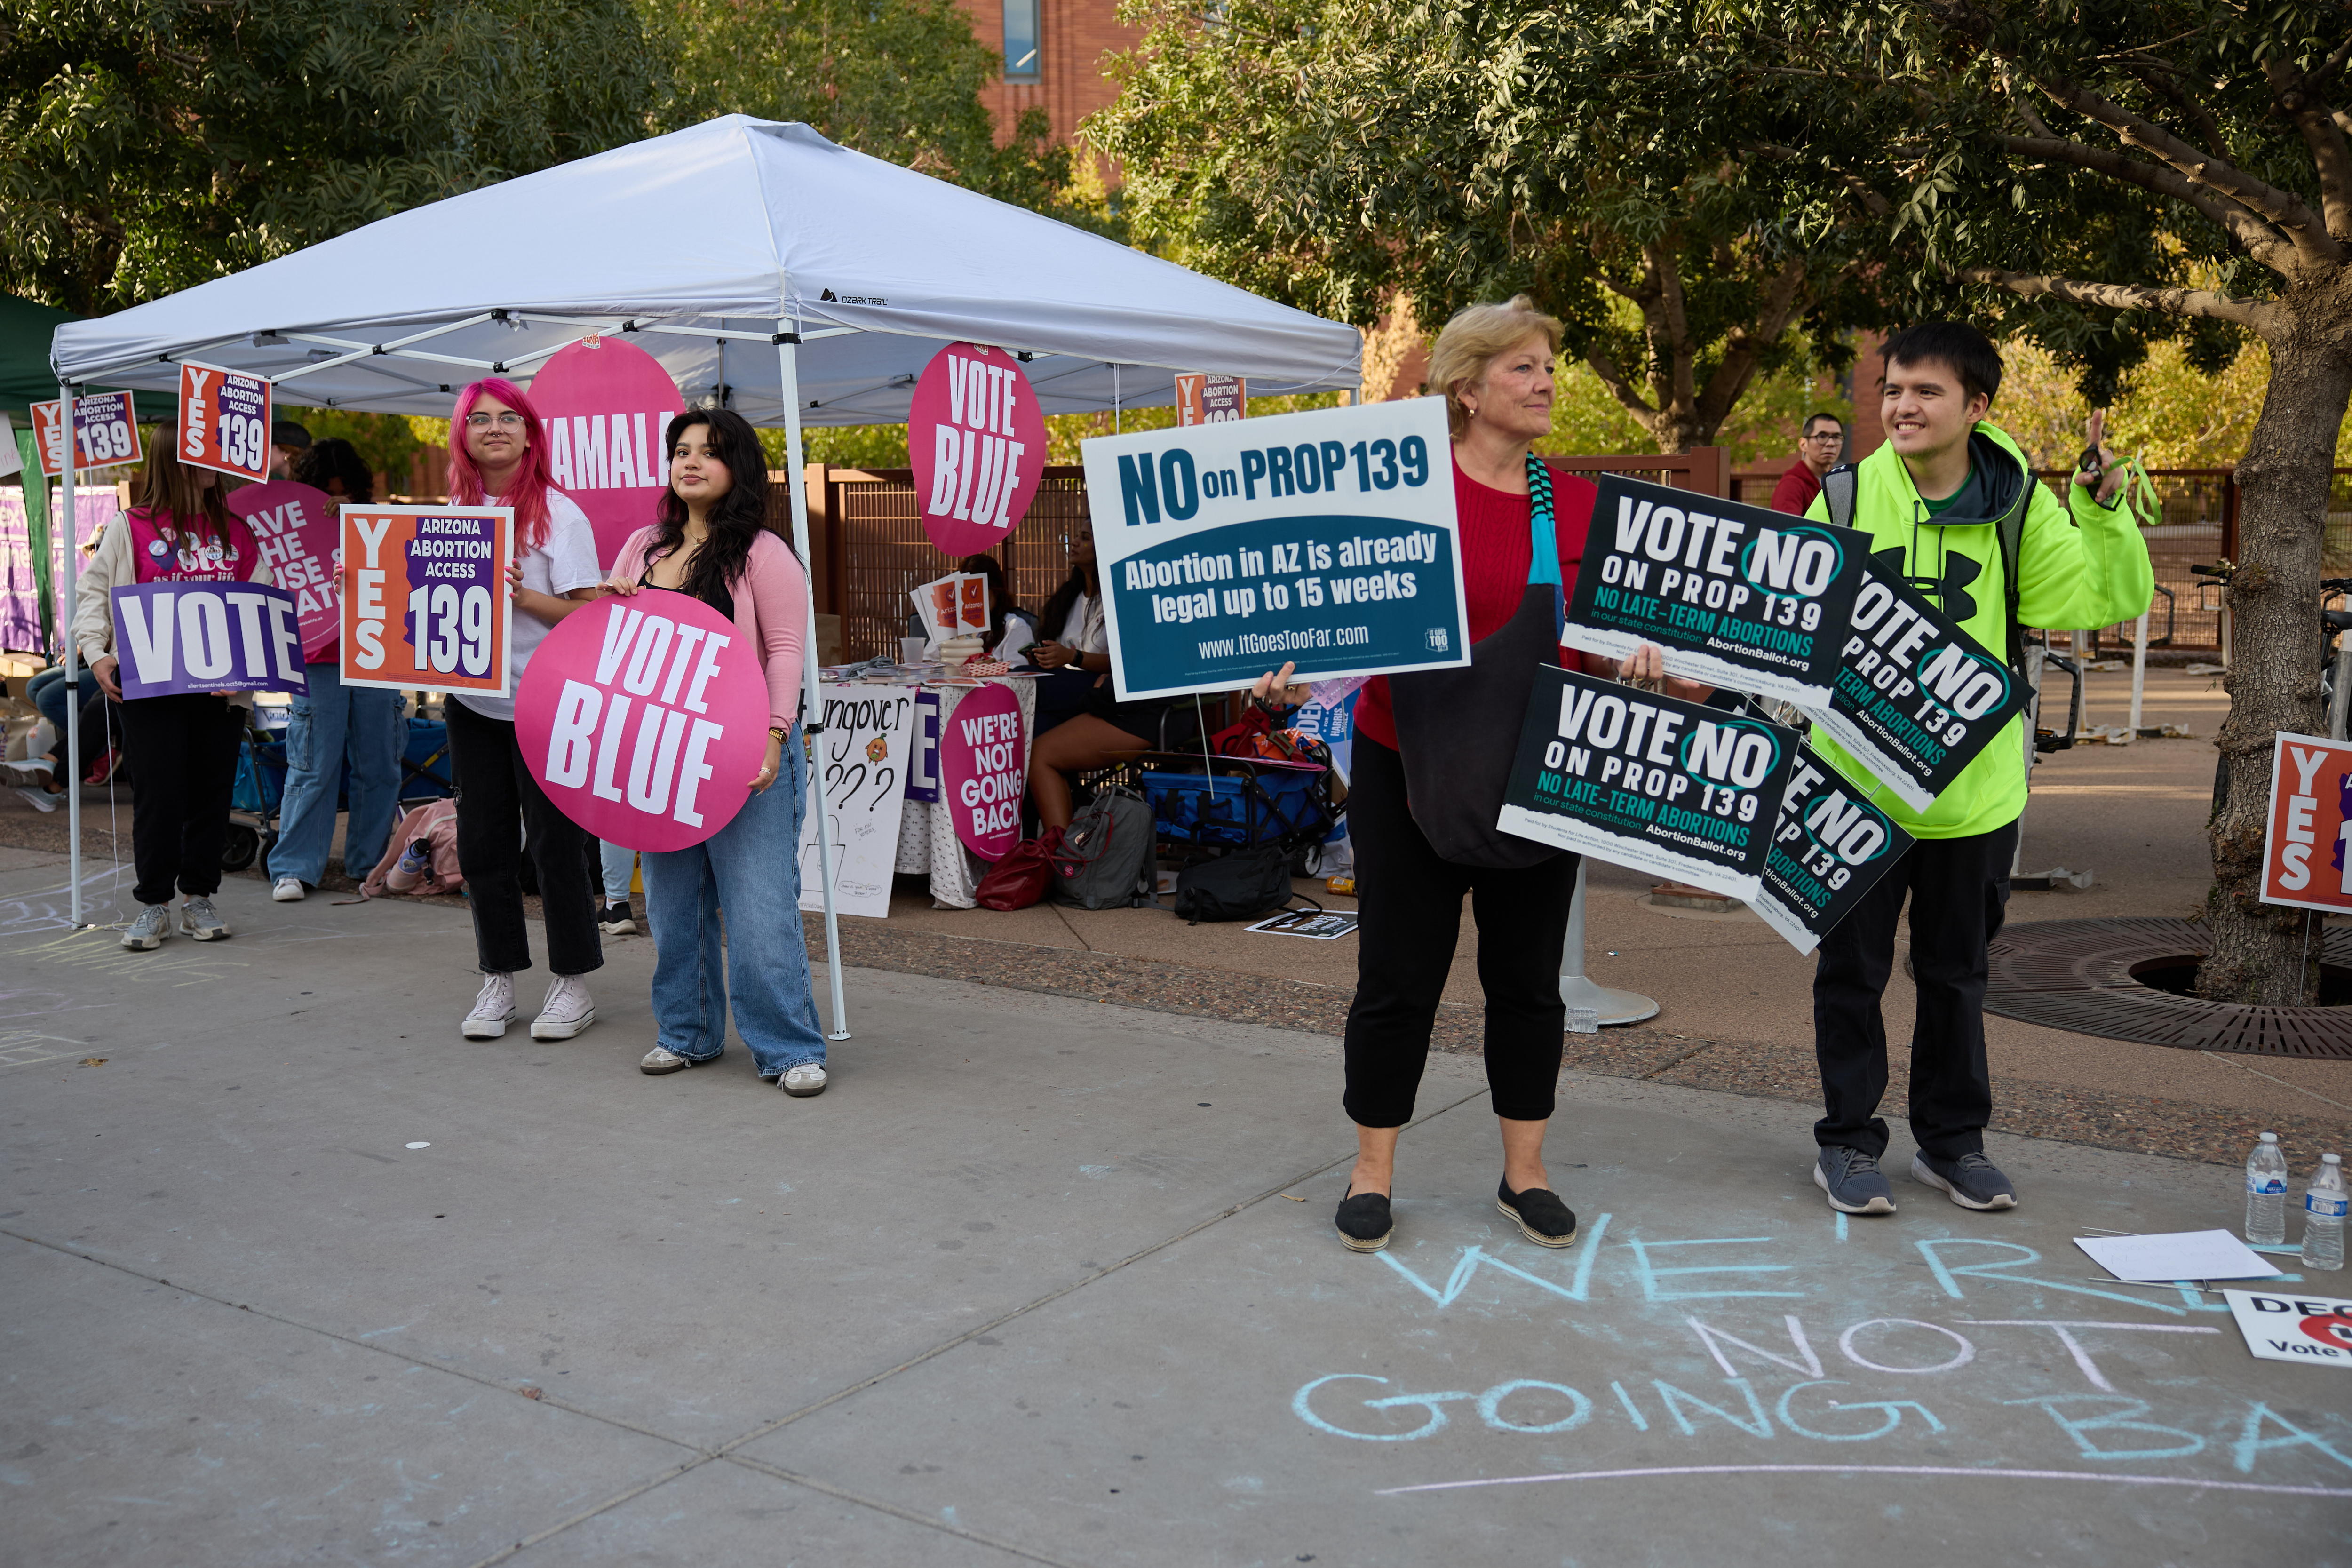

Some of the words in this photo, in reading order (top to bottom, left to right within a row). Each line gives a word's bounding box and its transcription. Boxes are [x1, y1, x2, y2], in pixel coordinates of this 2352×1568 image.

[220, 386, 264, 405] ABORTION
[227, 375, 259, 390] ARIZONA
[948, 354, 1016, 437] VOTE
[1203, 385, 1239, 398] ABORTION
[1207, 375, 1233, 384] ARIZONA
[74, 402, 124, 417] ABORTION
[79, 395, 116, 406] ARIZONA
[85, 414, 116, 423] ACCESS
[185, 367, 210, 457] YES
[229, 400, 256, 415] ACCESS
[1179, 378, 1195, 426] YE
[1210, 398, 1232, 407] ACCESS
[77, 420, 132, 462] 139
[219, 413, 264, 471] 139
[928, 424, 1025, 528] BLUE
[1118, 448, 1200, 527] NO
[1202, 466, 1239, 499] on
[246, 500, 307, 538] AVE
[421, 519, 481, 535] ARIZONA
[259, 531, 305, 567] HE
[411, 540, 492, 559] ABORTION
[1125, 552, 1234, 591] Abortion
[1239, 546, 1264, 578] in
[1272, 542, 1302, 575] AZ
[1306, 539, 1332, 570] is
[1338, 530, 1437, 566] already
[1615, 496, 1745, 577] VOTE
[1748, 527, 1835, 597] NO
[425, 562, 476, 579] ACCESS
[353, 518, 392, 671] YES
[1152, 586, 1217, 625] legal
[1224, 586, 1256, 618] up
[1264, 581, 1290, 611] to
[1295, 578, 1324, 608] 15
[1330, 570, 1417, 605] weeks
[1601, 555, 1648, 590] ON
[1660, 568, 1749, 613] PROP
[1763, 593, 1822, 631] 139
[119, 592, 305, 685] VOTE
[409, 584, 492, 676] 139
[1429, 635, 1447, 647] TOO
[1591, 609, 1599, 617] in
[1601, 612, 1617, 623] our
[1619, 615, 1643, 629] state
[1644, 623, 1704, 645] constitution.
[1594, 586, 1620, 610] NO
[1621, 596, 1716, 634] LATE-TERM
[1717, 616, 1813, 657] ABORTIONS
[595, 603, 731, 714] VOTE
[1198, 626, 1369, 660] www.ItGoesTooFar.com
[1707, 637, 1810, 672] AbortionBallot.org
[1842, 636, 1915, 700] PROP
[1914, 699, 1966, 747] 139
[1918, 642, 2003, 721] NO
[961, 711, 1018, 747] WE'RE
[1330, 708, 1343, 736] HARRIS
[1557, 684, 1685, 766] VOTE
[1686, 720, 1773, 788] NO
[1822, 711, 1844, 730] Winchester
[1852, 738, 1862, 748] Suite
[1825, 721, 1842, 737] candidate
[1869, 693, 1946, 765] ABORTIONS
[545, 679, 724, 828] BLUE
[975, 741, 1014, 775] NOT
[1856, 709, 1933, 776] AbortionBallot.org
[961, 768, 1022, 807] GOING
[1544, 741, 1591, 777] ON
[1601, 756, 1689, 802] PROP
[1700, 782, 1758, 822] 139
[972, 798, 1020, 836] BACK
[1534, 792, 1542, 801] in
[1543, 796, 1559, 806] our
[1560, 800, 1584, 813] state
[1585, 808, 1643, 831] constitution.
[1537, 770, 1562, 794] NO
[1563, 780, 1655, 820] LATE-TERM
[1656, 804, 1750, 847] ABORTIONS
[1804, 789, 1885, 866] NO
[2278, 747, 2329, 891] YES
[1548, 824, 1568, 833] Students
[1614, 843, 1638, 854] Winchester
[1582, 840, 1605, 850] authorized
[1621, 850, 1643, 860] candidate
[1646, 824, 1746, 861] AbortionBallot.org
[1767, 844, 1832, 908] BORTIONS
[1801, 843, 1851, 890] 139
[1687, 1315, 2221, 1393] NOT
[2266, 1339, 2340, 1357] Vote
[1291, 1372, 1946, 1441] GOING
